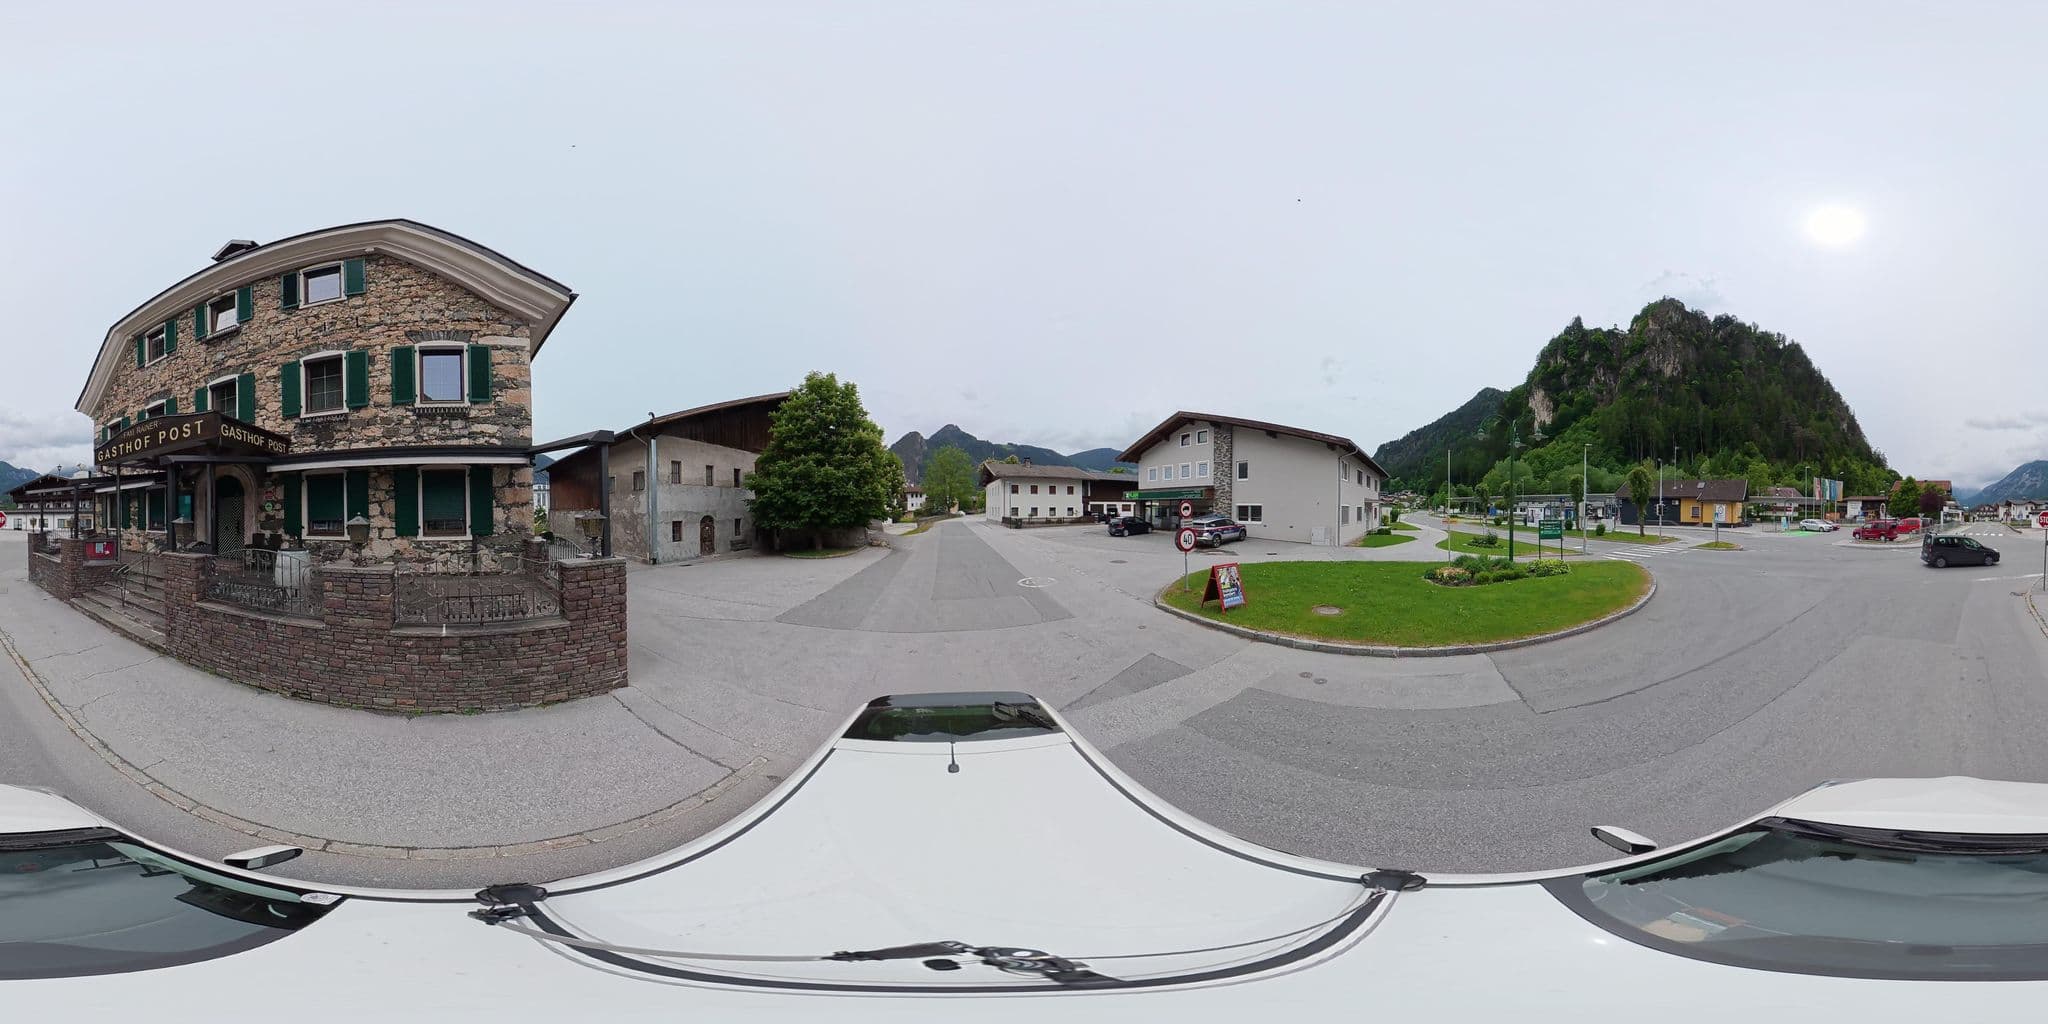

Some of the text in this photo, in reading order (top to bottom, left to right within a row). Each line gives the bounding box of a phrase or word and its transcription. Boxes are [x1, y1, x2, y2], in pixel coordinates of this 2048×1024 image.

[97, 419, 204, 462] GASTHOF POST
[220, 424, 287, 454] GASTHOF POST
[1183, 534, 1193, 545] 40
